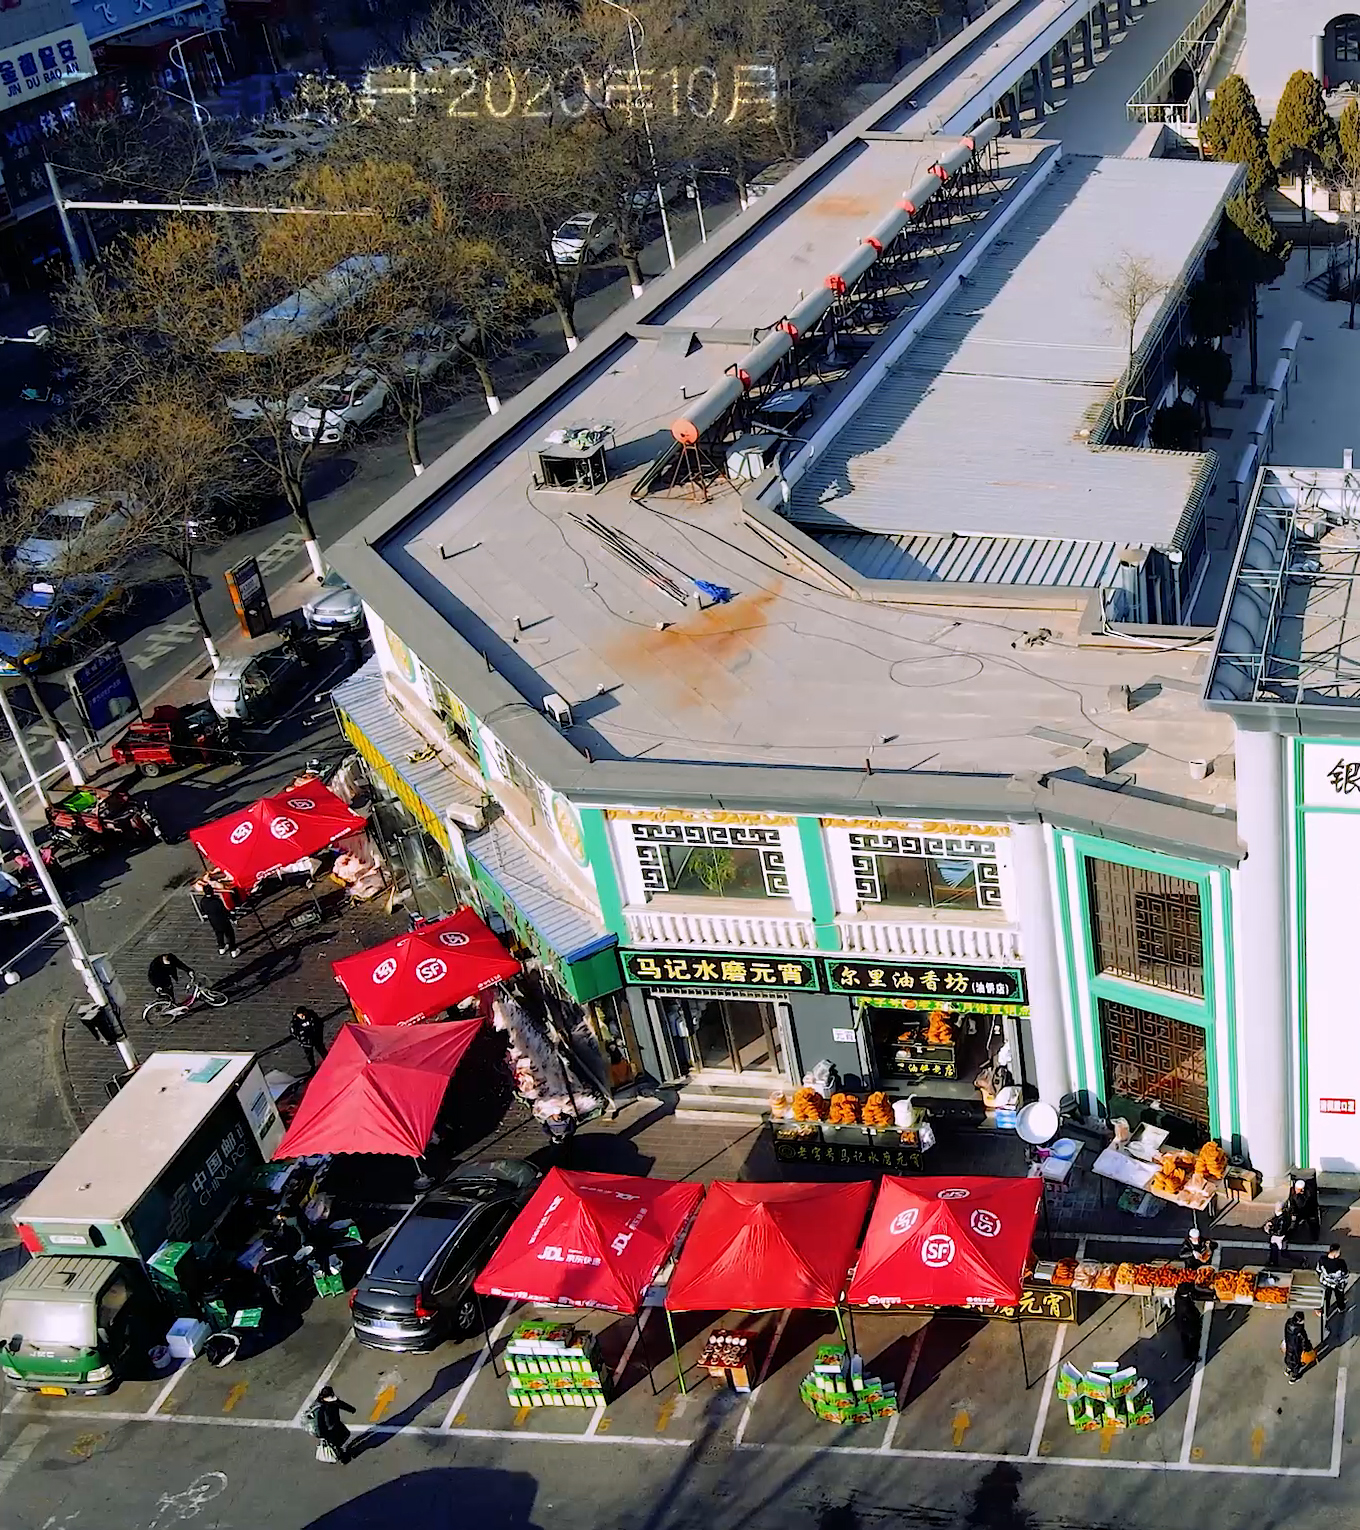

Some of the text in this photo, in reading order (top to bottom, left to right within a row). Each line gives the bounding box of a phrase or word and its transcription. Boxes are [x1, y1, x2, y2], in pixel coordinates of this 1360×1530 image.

[7, 62, 79, 97] JIN DU BAO AN
[636, 957, 803, 985] 马记水磨元宵
[840, 966, 970, 993] 尔里油香坊
[199, 1163, 233, 1206] CHINA
[537, 1246, 564, 1262] JDL
[610, 1230, 634, 1256] JDL
